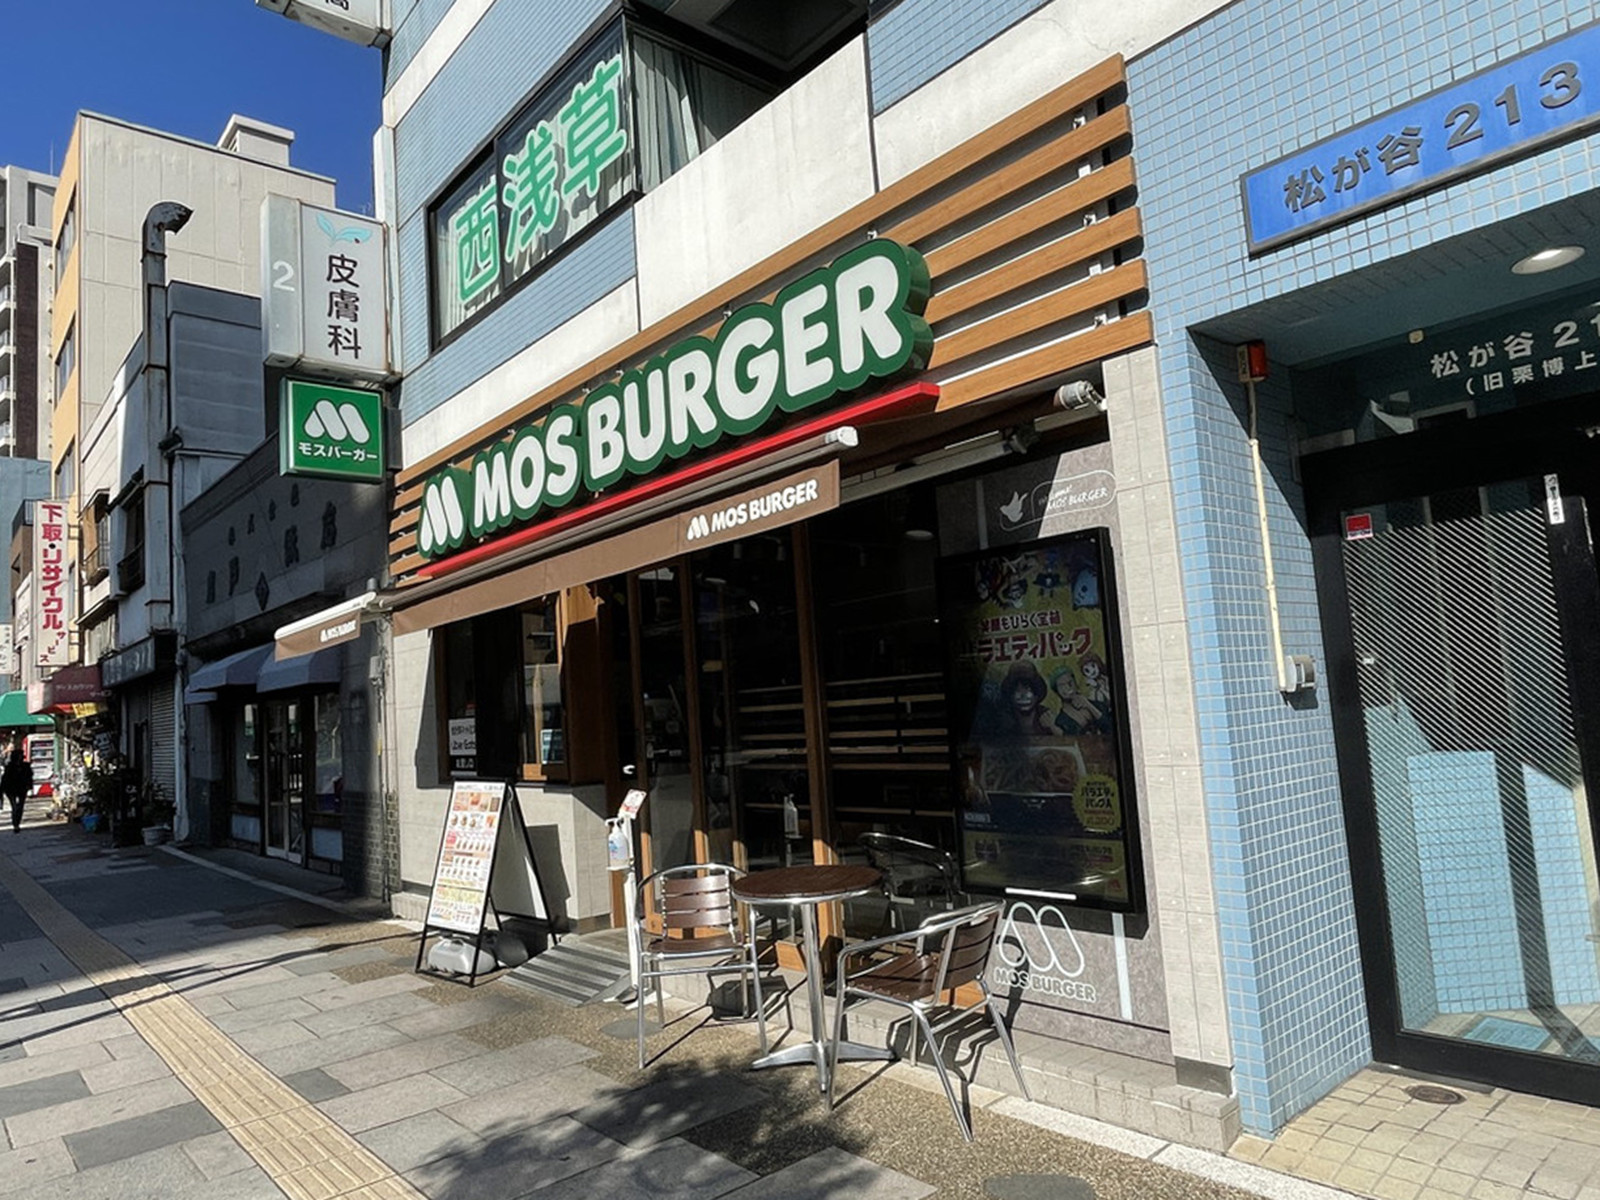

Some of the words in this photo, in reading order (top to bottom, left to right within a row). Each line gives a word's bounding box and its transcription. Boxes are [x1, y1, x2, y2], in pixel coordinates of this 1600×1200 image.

[1283, 126, 1424, 213] 松が谷
[1444, 61, 1582, 150] 213
[455, 53, 627, 302] 西浅草
[272, 259, 296, 292] 2
[326, 253, 362, 359] 皮膚科
[1430, 331, 1535, 379] 松が谷
[474, 413, 580, 530] MOS
[586, 255, 903, 481] BURGER
[298, 442, 378, 462] モスバーガー
[711, 502, 748, 533] MOS
[749, 478, 818, 521] BURGER
[40, 631, 66, 663] サービス
[994, 967, 1030, 990] MOS
[1030, 974, 1097, 1003] BURGER
